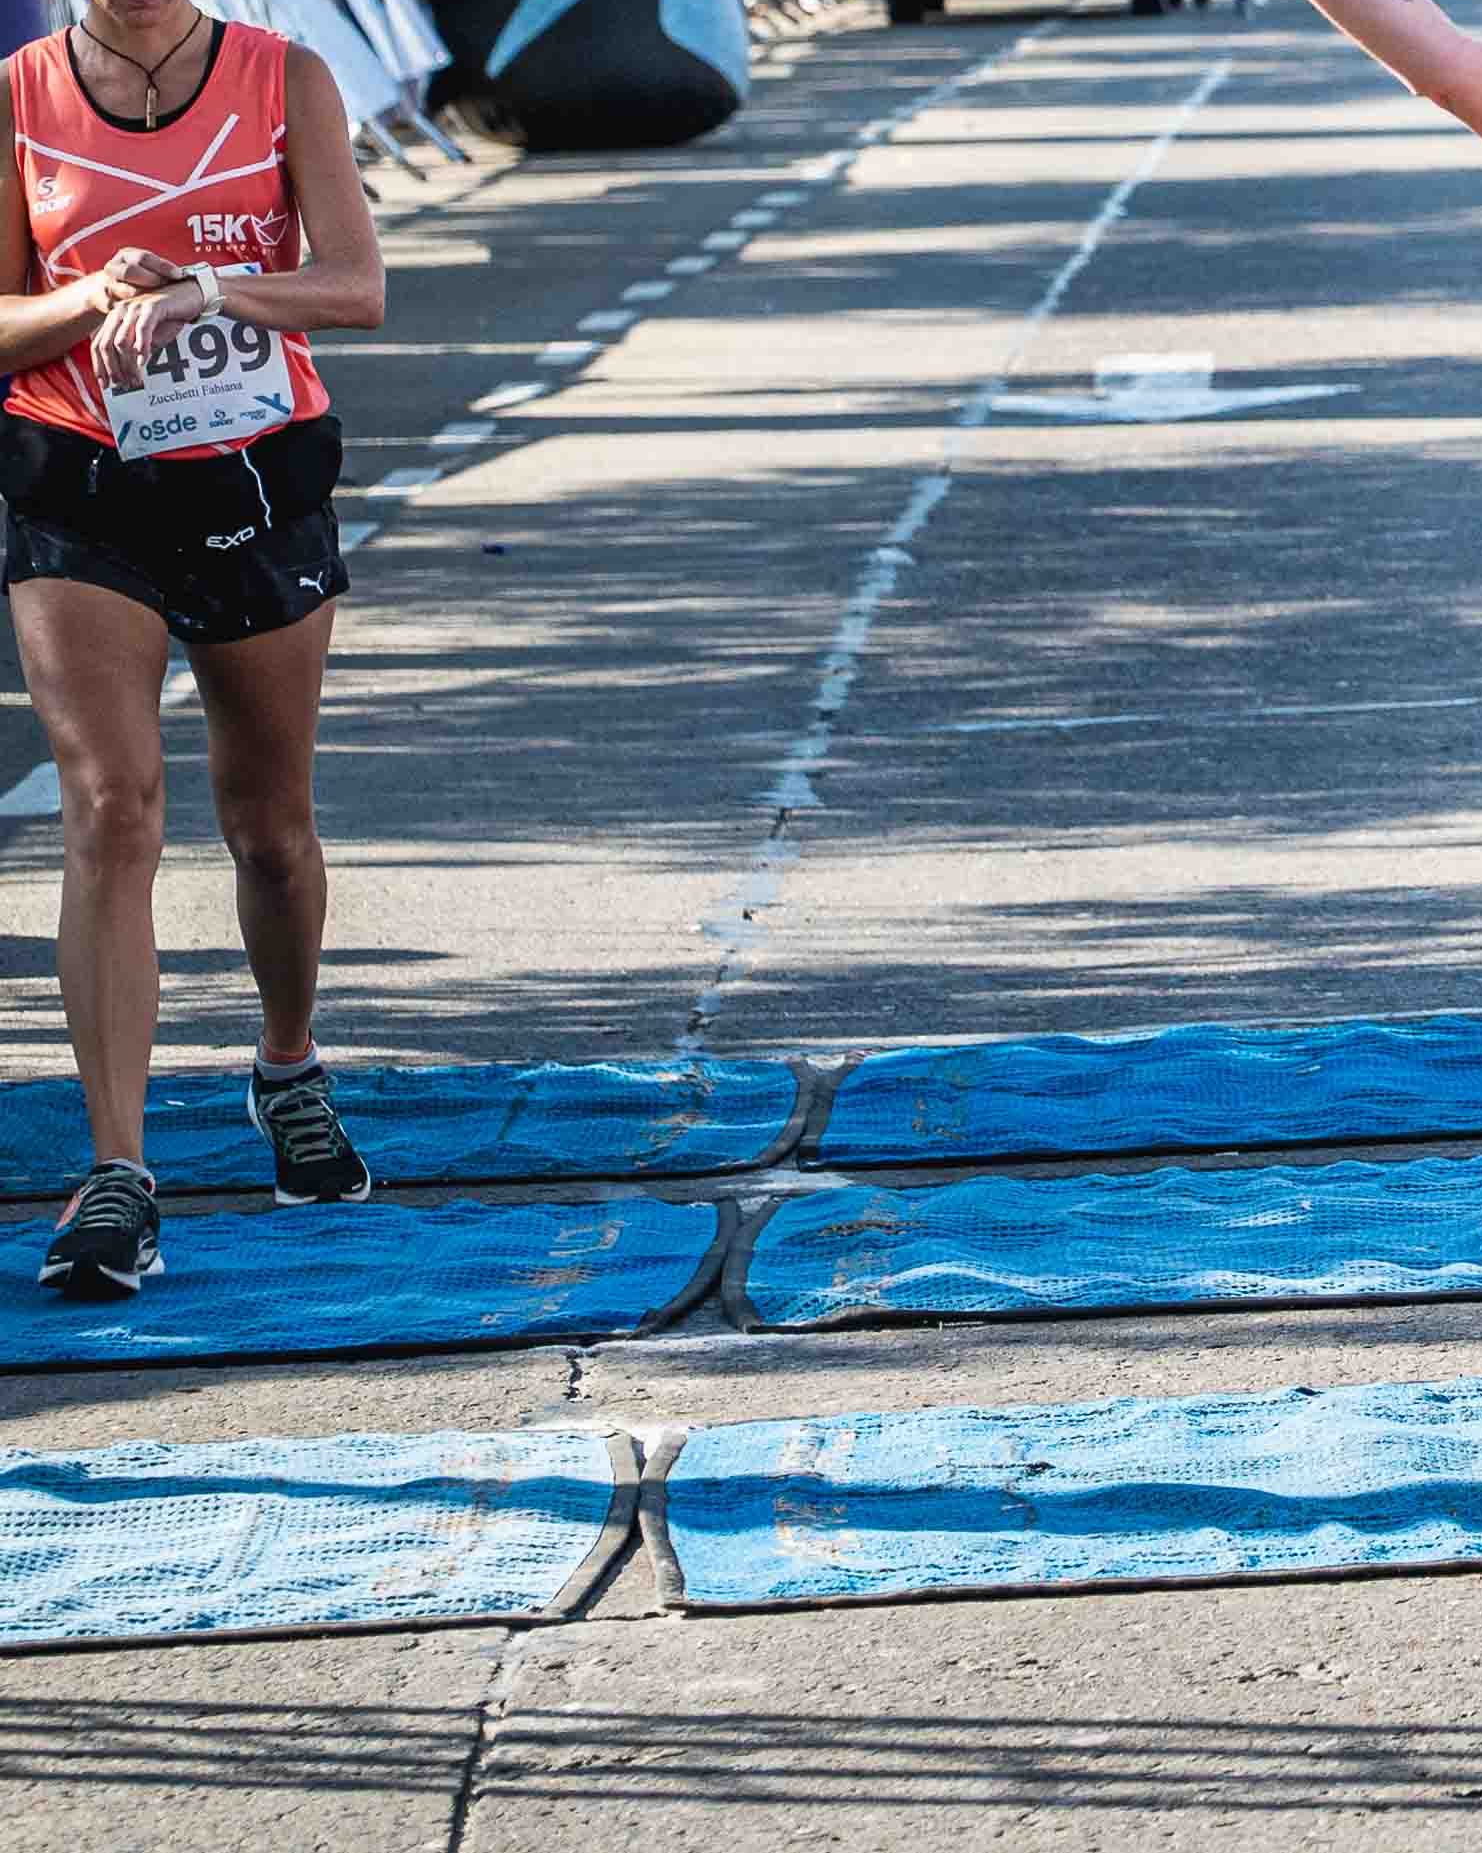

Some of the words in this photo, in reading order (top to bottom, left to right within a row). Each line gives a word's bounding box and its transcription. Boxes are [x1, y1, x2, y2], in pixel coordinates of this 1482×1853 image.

[186, 213, 251, 244] 15K
[111, 323, 272, 397] 499
[202, 381, 244, 397] Fabiana
[139, 413, 197, 442] osde
